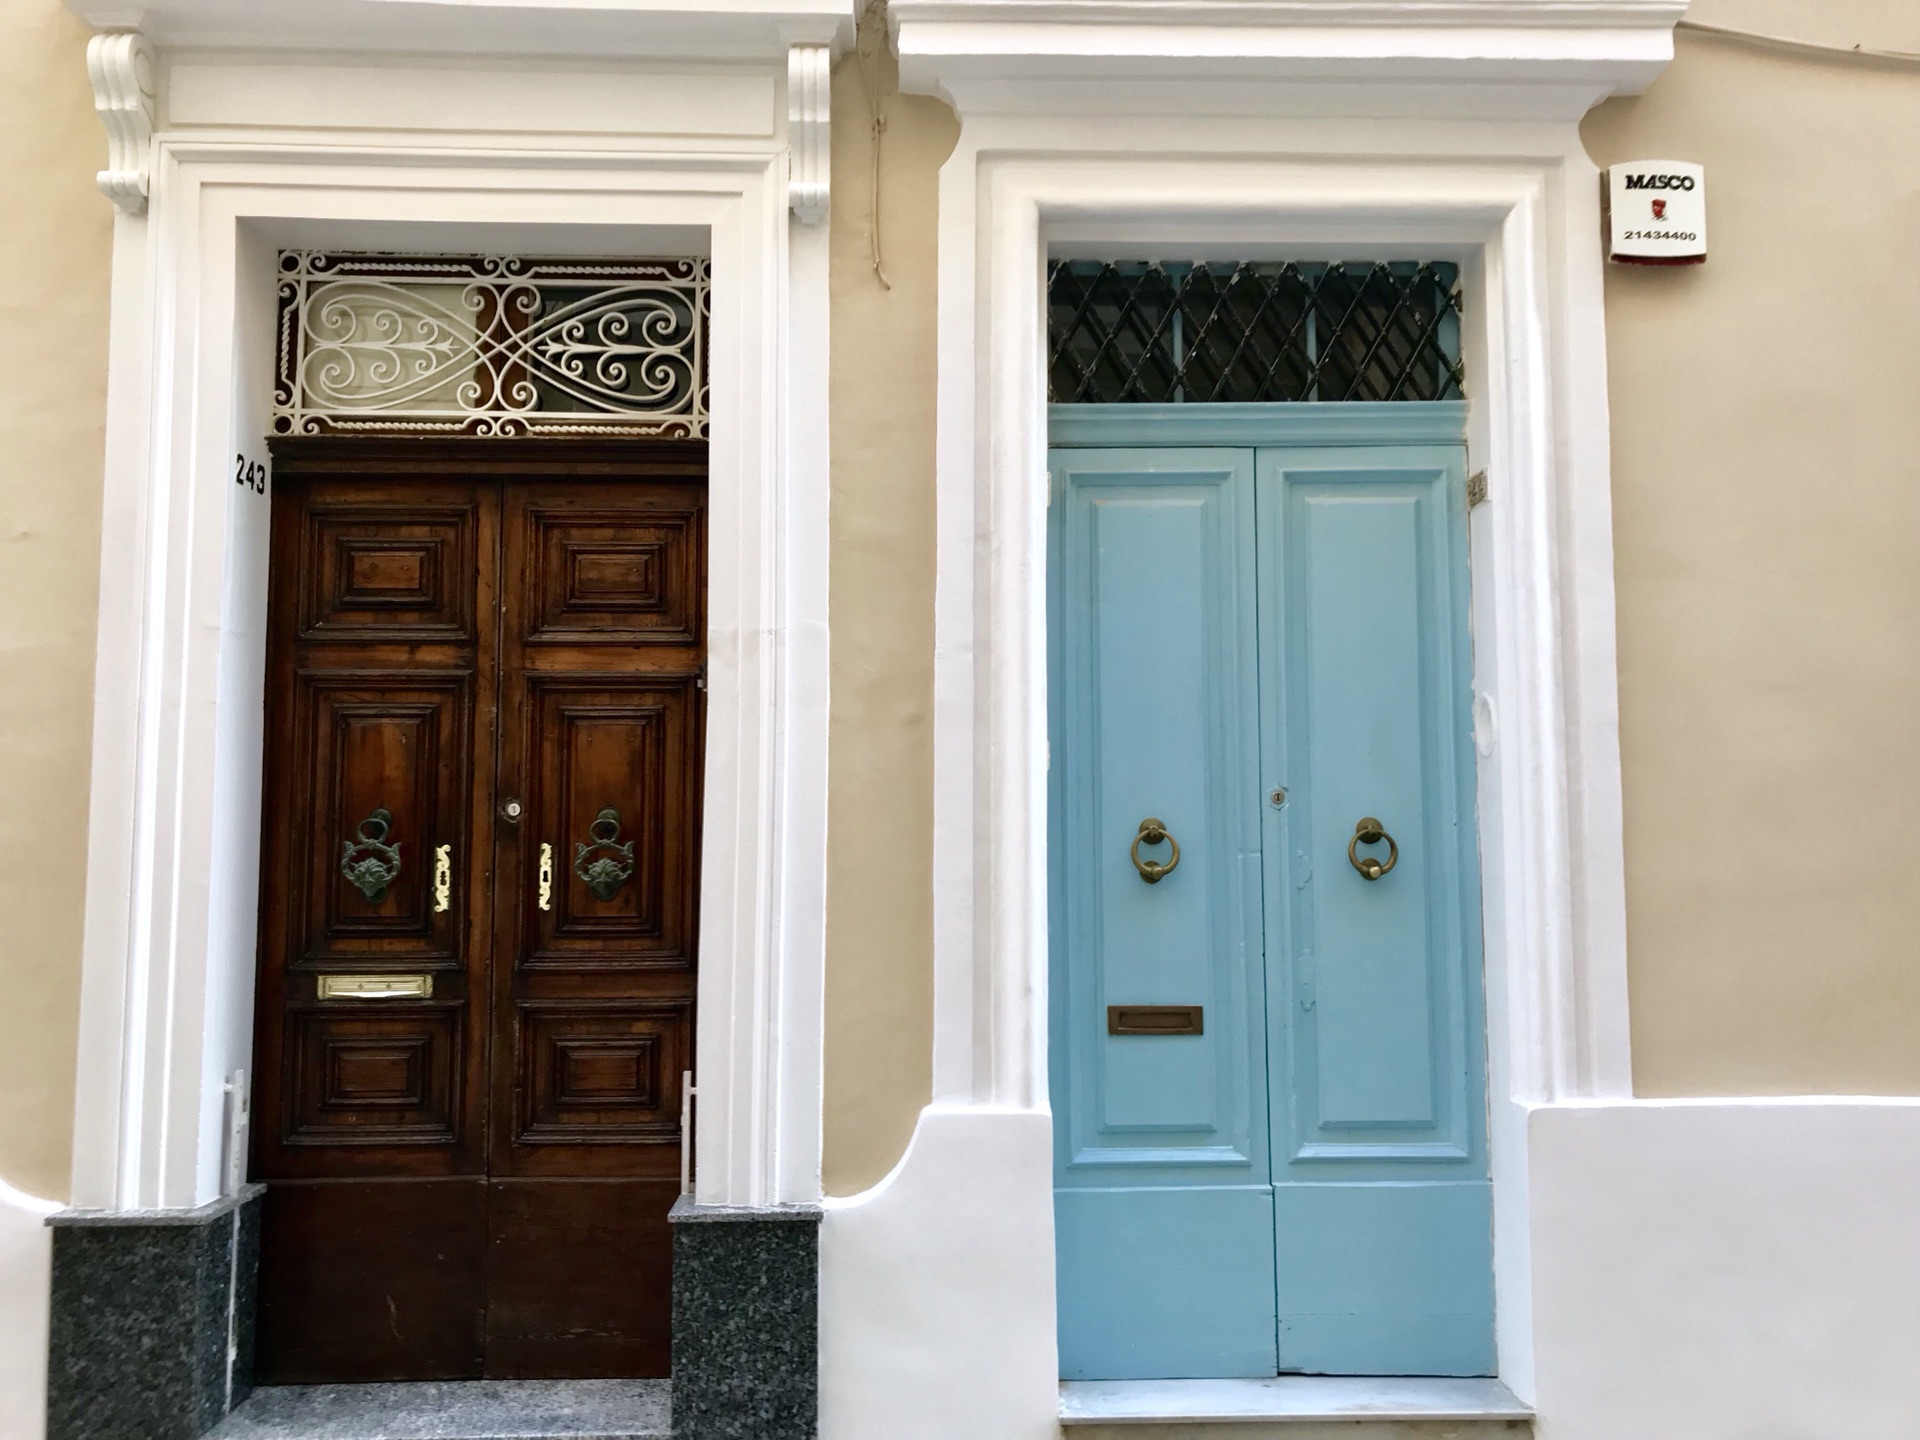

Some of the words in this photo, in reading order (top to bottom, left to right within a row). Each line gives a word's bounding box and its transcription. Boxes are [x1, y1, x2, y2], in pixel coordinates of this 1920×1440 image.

[1625, 174, 1695, 192] MASCO
[1624, 230, 1697, 242] 21434400
[236, 453, 265, 495] 243
